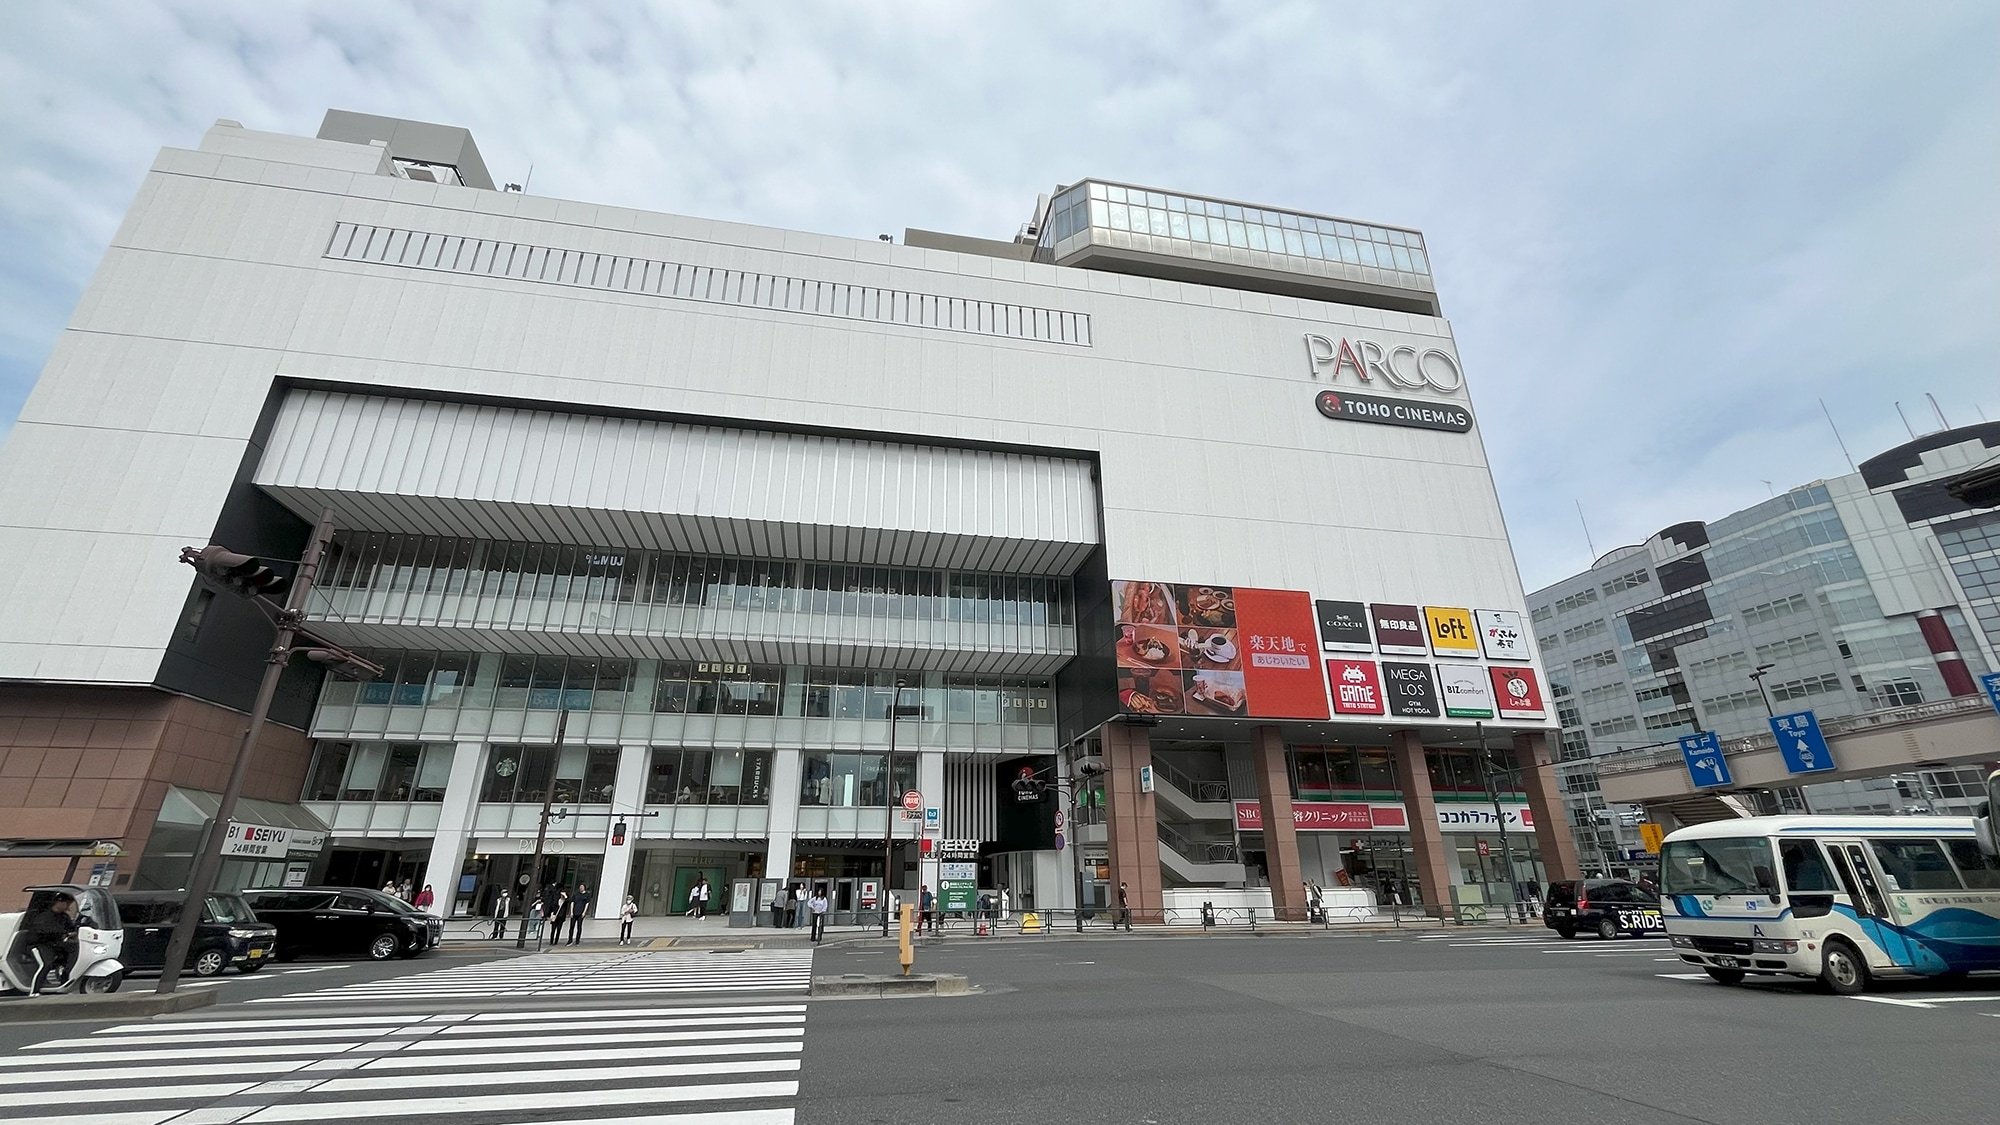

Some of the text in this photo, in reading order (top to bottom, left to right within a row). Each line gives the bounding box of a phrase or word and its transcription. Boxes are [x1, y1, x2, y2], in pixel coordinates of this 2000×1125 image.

[1304, 333, 1464, 392] PARCO
[1344, 400, 1467, 426] TOHO CINEMAS
[1380, 619, 1418, 631] 無印良品
[1249, 634, 1307, 652] 楽天地で
[1257, 656, 1306, 665] あじわいたい
[1391, 669, 1428, 681] MEGA
[1340, 685, 1375, 703] GAME
[1399, 684, 1425, 697] LOS
[1787, 729, 1806, 737] Toyo
[1706, 757, 1714, 766] 14
[753, 757, 762, 799] STARBUCKS
[1239, 809, 1260, 819] SBC
[228, 826, 240, 839] B1
[254, 828, 287, 843] SEIYU
[231, 844, 268, 854] 24時間営業
[517, 839, 565, 854] PACO
[932, 839, 979, 853] SEIYU
[1620, 914, 1664, 929] S.RIDE
[1753, 924, 1765, 937] A
